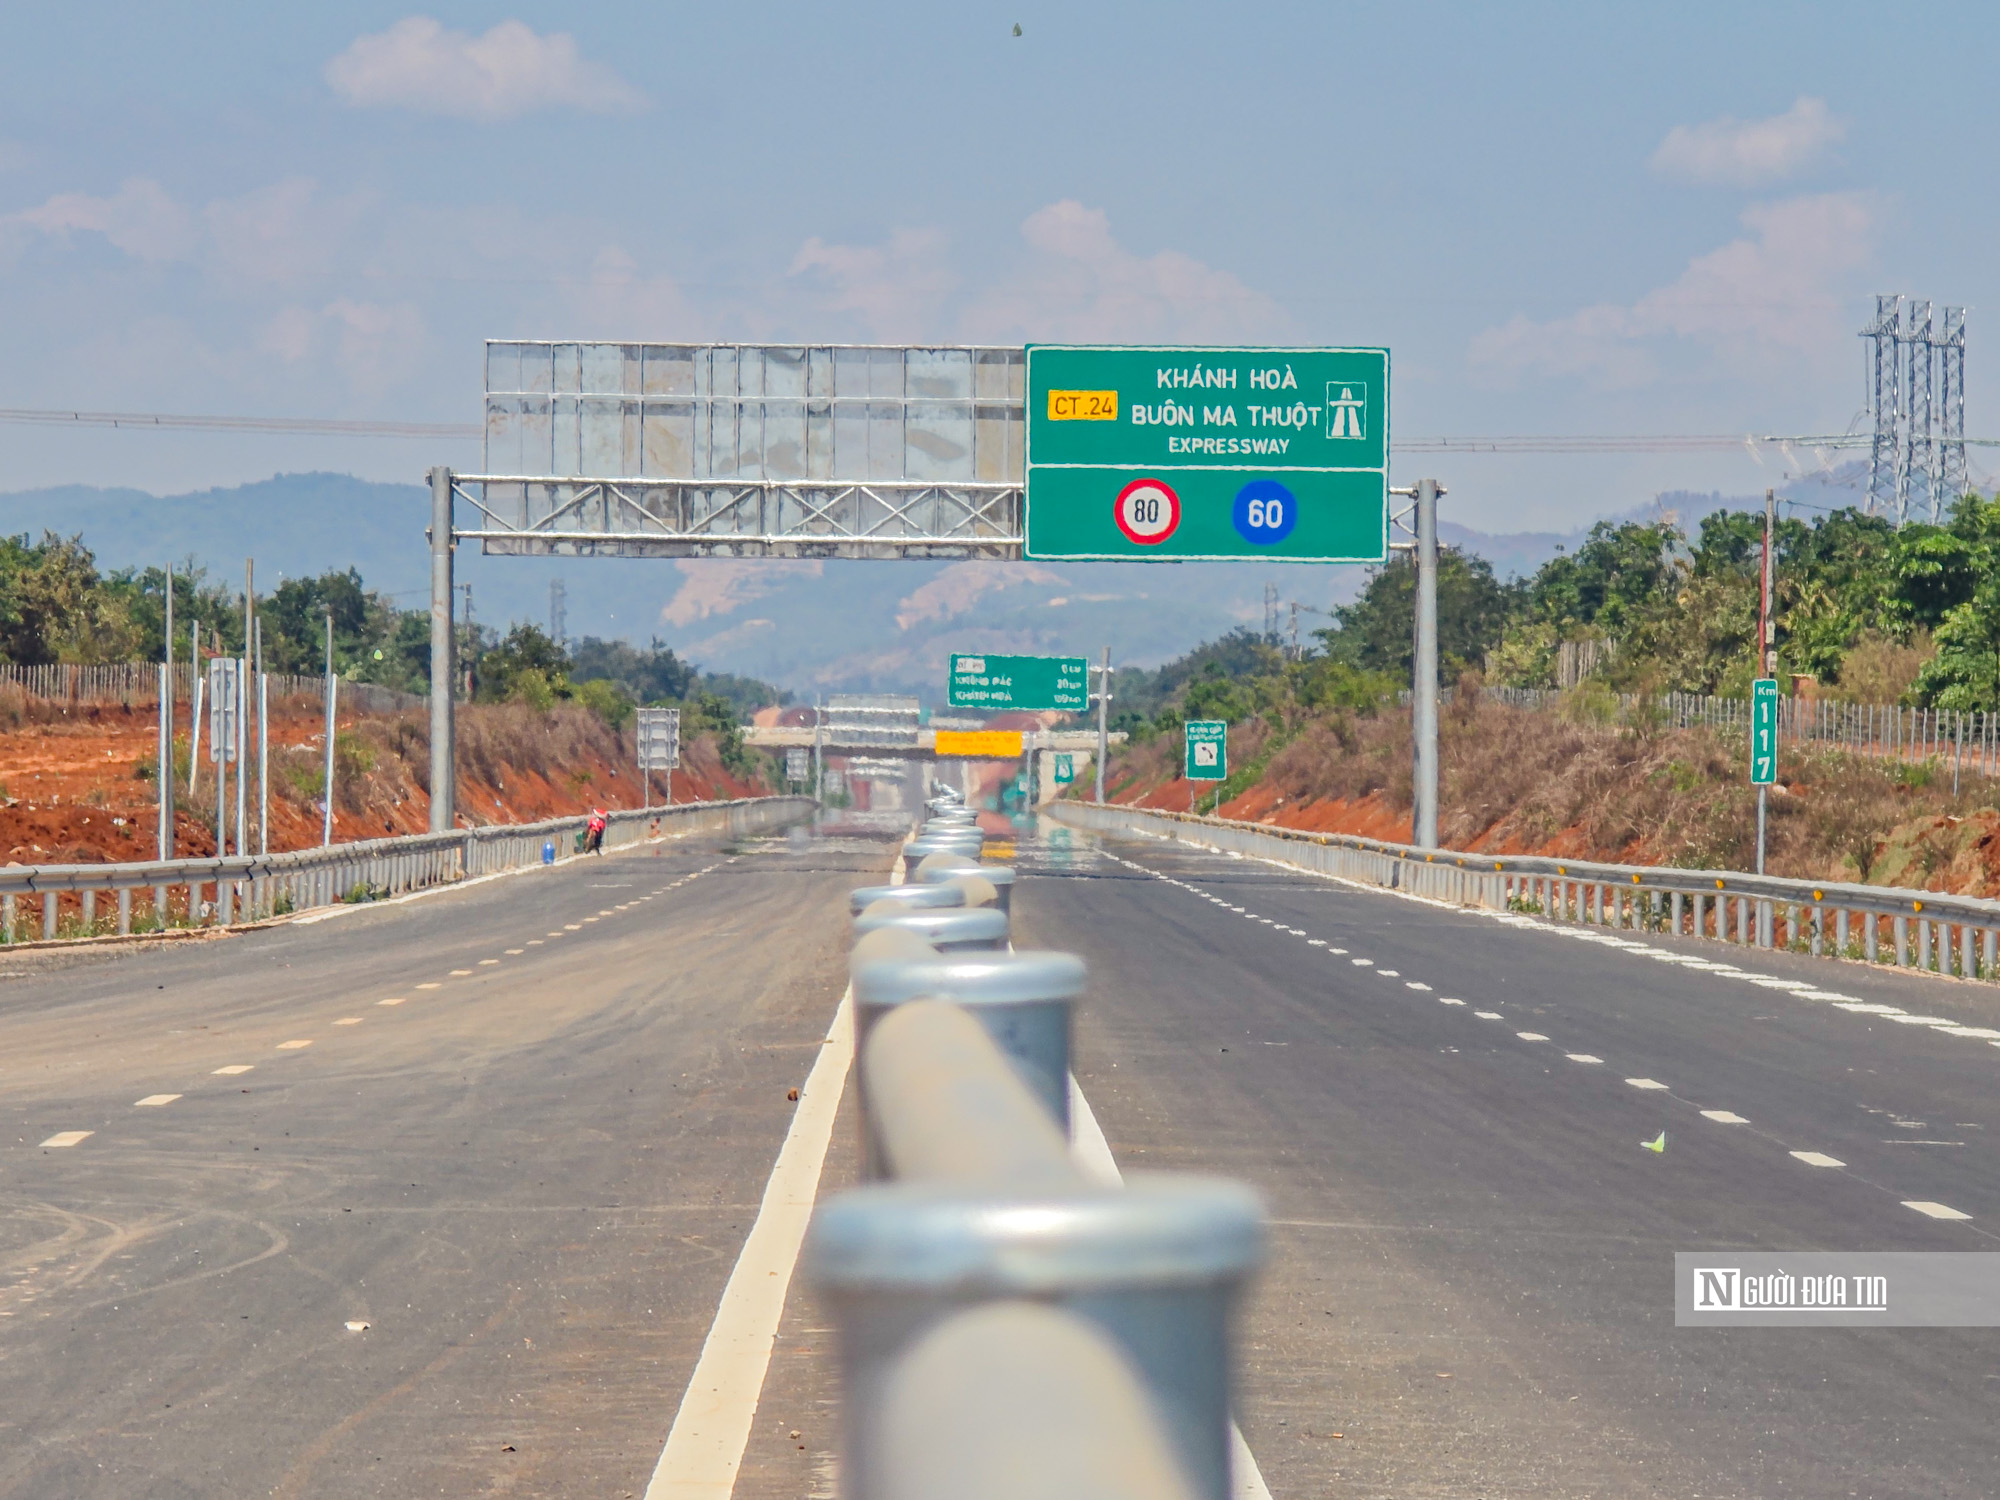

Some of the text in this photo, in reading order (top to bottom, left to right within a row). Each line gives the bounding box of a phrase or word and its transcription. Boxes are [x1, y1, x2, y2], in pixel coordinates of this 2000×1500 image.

[1156, 363, 1298, 390] KHÁNH HOÀ
[1054, 396, 1113, 416] CT.24
[1131, 398, 1322, 432] BUÔN MA THUỘT
[1168, 436, 1290, 455] EXPRESSWAY
[1133, 498, 1160, 524] 80
[1247, 499, 1284, 529] 60
[1757, 686, 1776, 696] Km
[1757, 701, 1771, 780] 117
